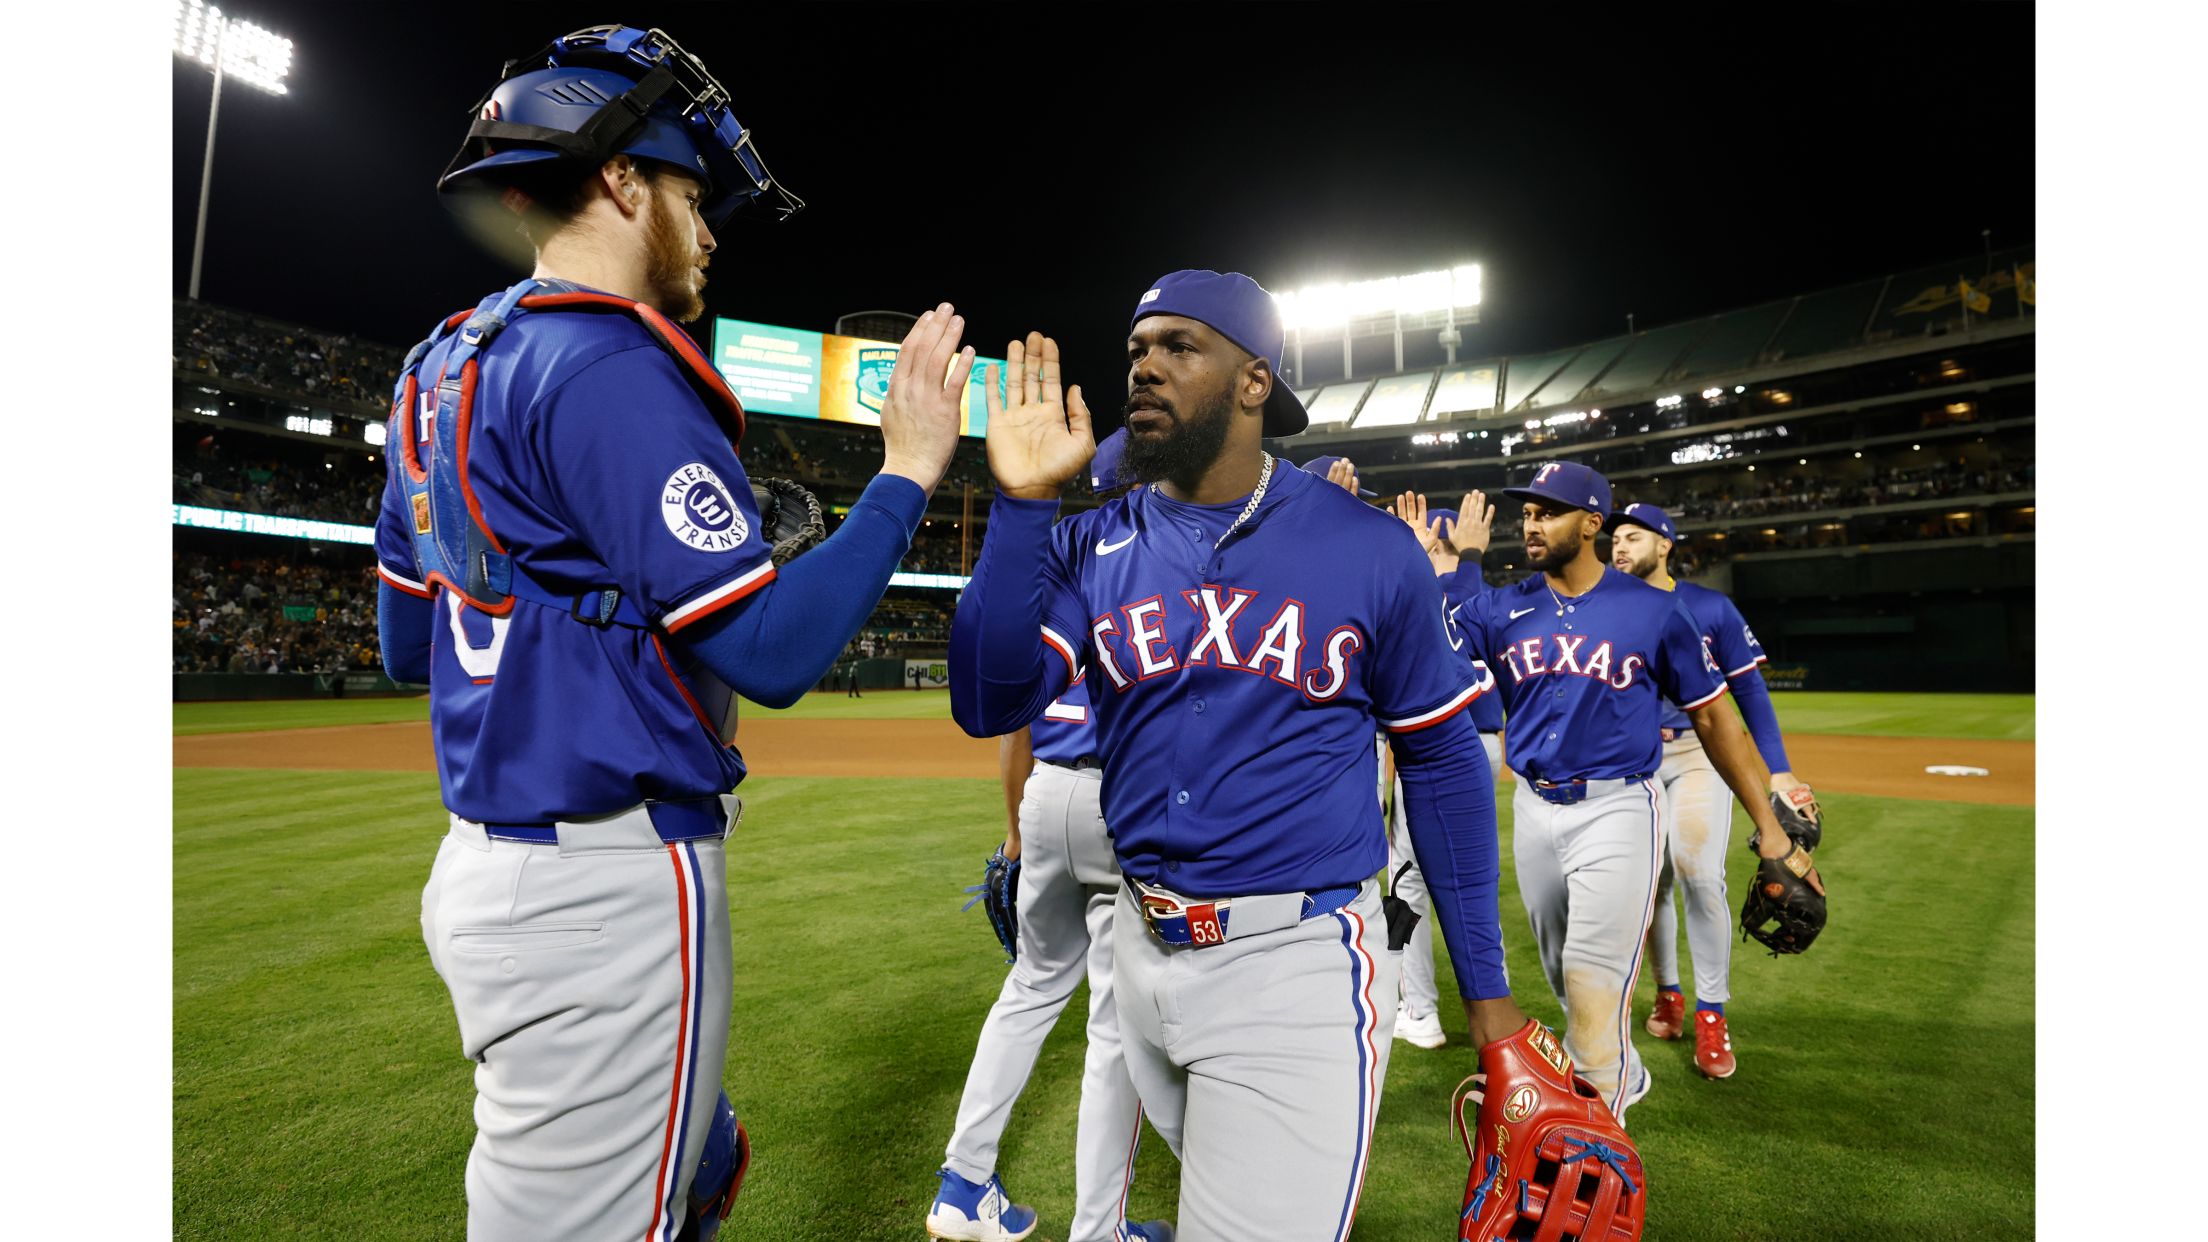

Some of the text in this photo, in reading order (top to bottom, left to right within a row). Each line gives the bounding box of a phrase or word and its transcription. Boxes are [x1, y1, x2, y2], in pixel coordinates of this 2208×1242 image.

[665, 465, 726, 505] ENERGY
[1536, 463, 1560, 483] T
[180, 506, 243, 530] PUBLIC
[1089, 583, 1364, 703] TEXAS
[1497, 634, 1645, 692] TEXAS
[1192, 920, 1219, 943] 53
